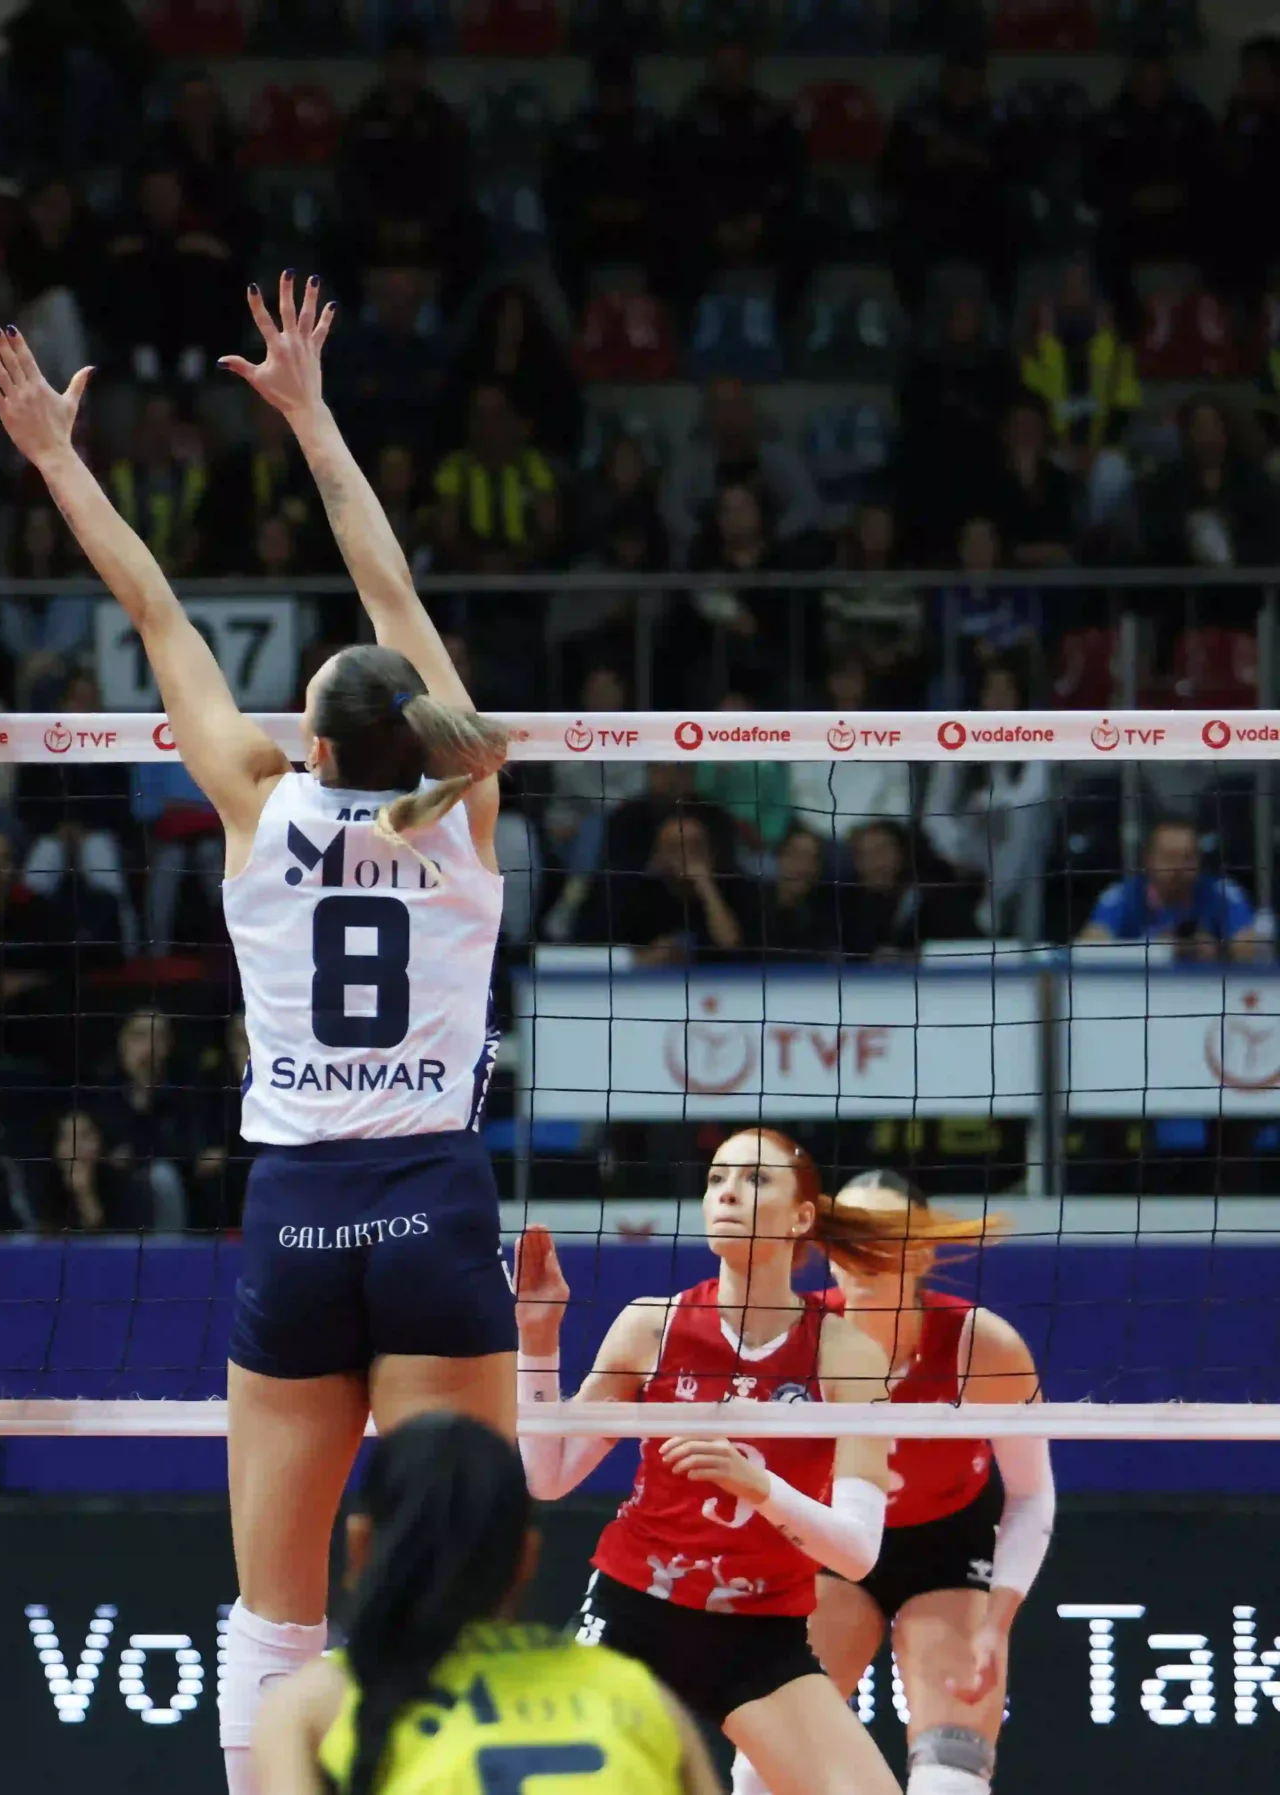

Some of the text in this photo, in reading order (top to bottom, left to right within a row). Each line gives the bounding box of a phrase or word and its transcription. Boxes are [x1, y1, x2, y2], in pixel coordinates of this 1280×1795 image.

[77, 732, 117, 748] TVF
[597, 730, 638, 747] TVF
[708, 727, 790, 743] vodafone
[860, 730, 901, 746] TVF
[971, 726, 1054, 742] vodafone
[1124, 729, 1165, 745] TVF
[312, 895, 410, 1048] 8
[770, 1027, 889, 1076] TVF
[270, 1056, 446, 1093] SANMAR
[278, 1212, 429, 1249] GALAKTOS
